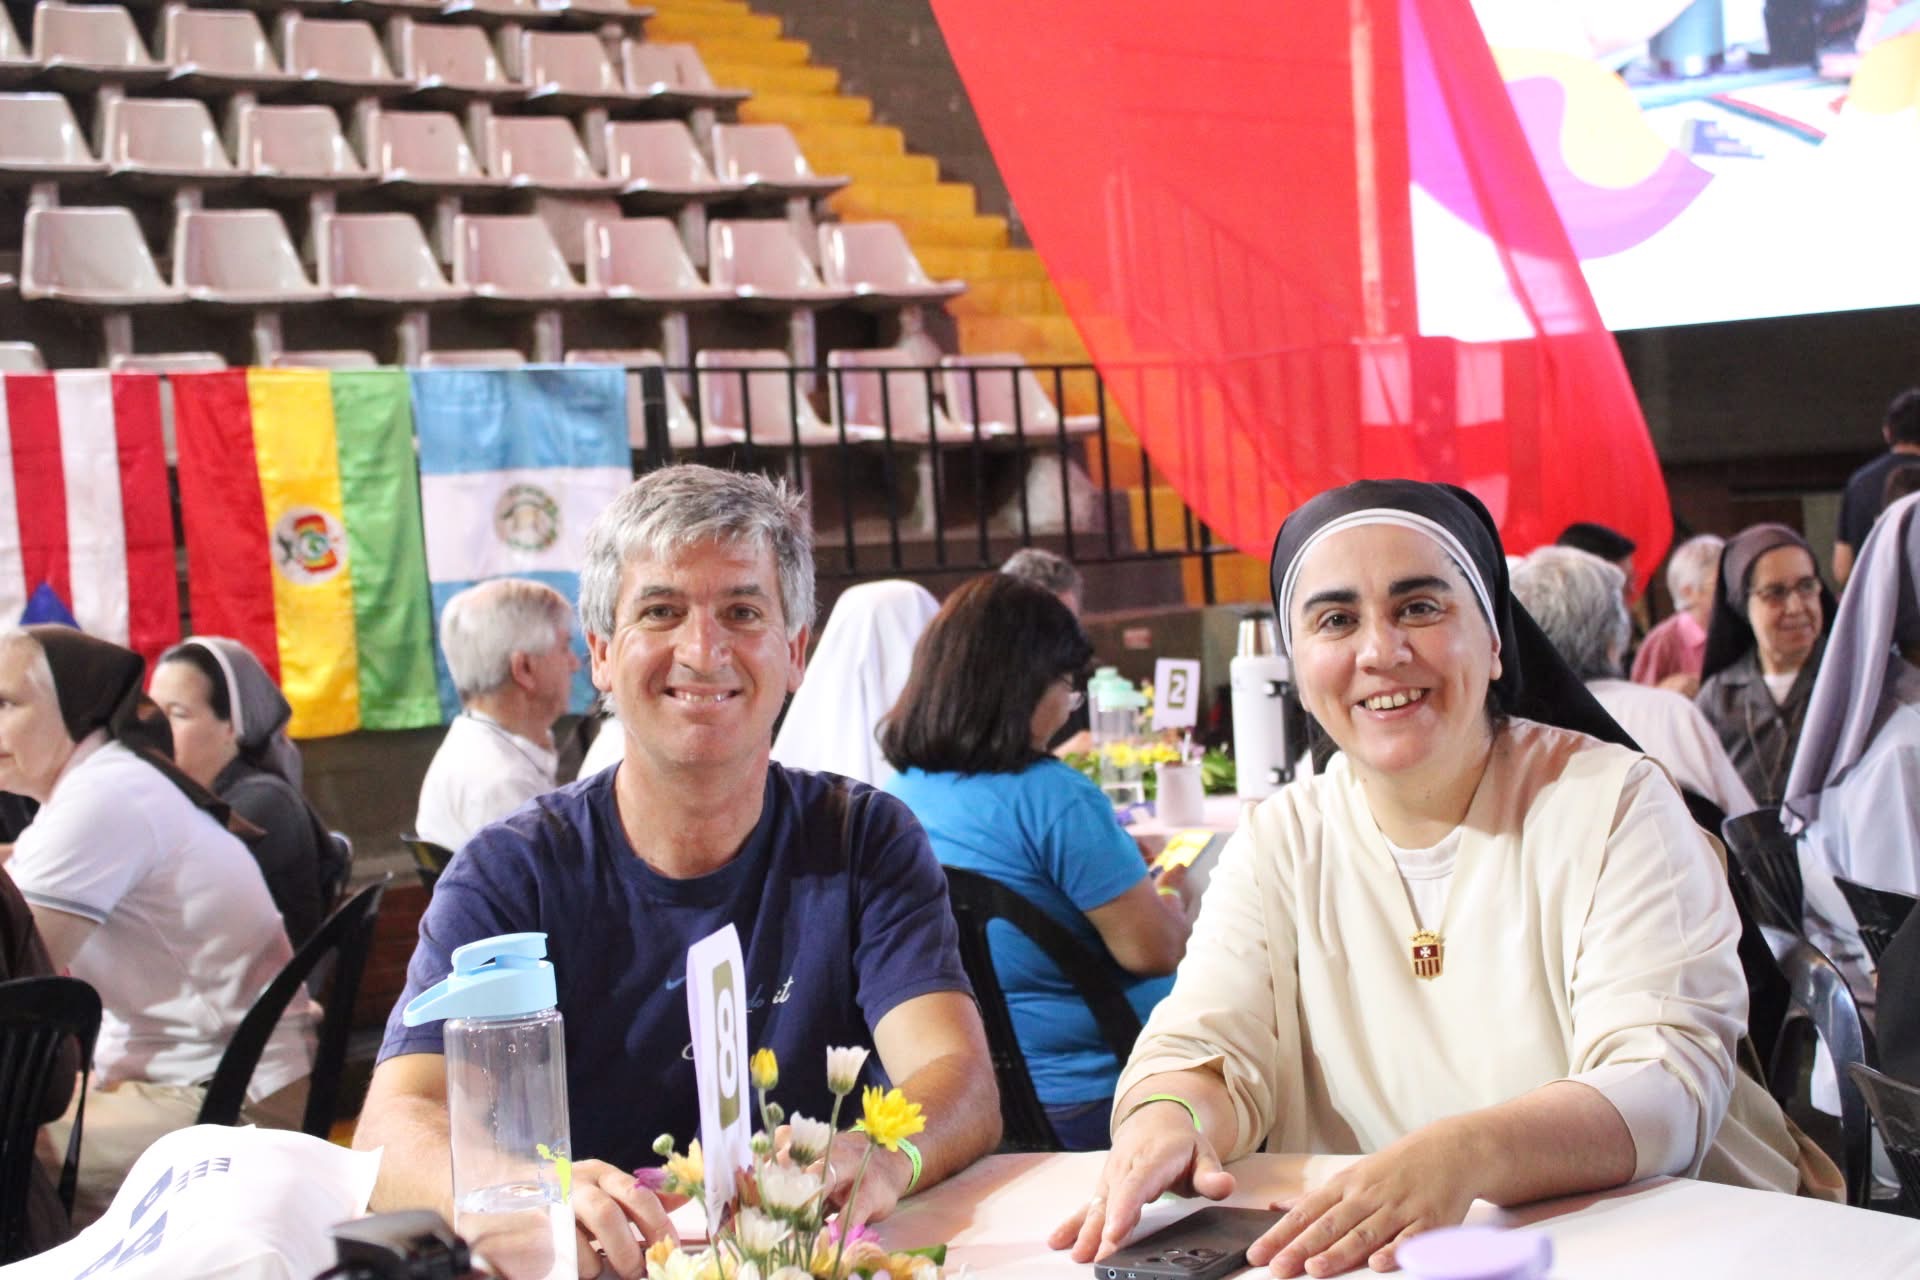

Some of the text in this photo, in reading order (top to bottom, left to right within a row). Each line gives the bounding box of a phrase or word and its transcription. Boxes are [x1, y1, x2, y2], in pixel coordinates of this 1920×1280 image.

[1169, 673, 1186, 703] 2
[772, 975, 795, 1004] it
[717, 988, 738, 1099] 8
